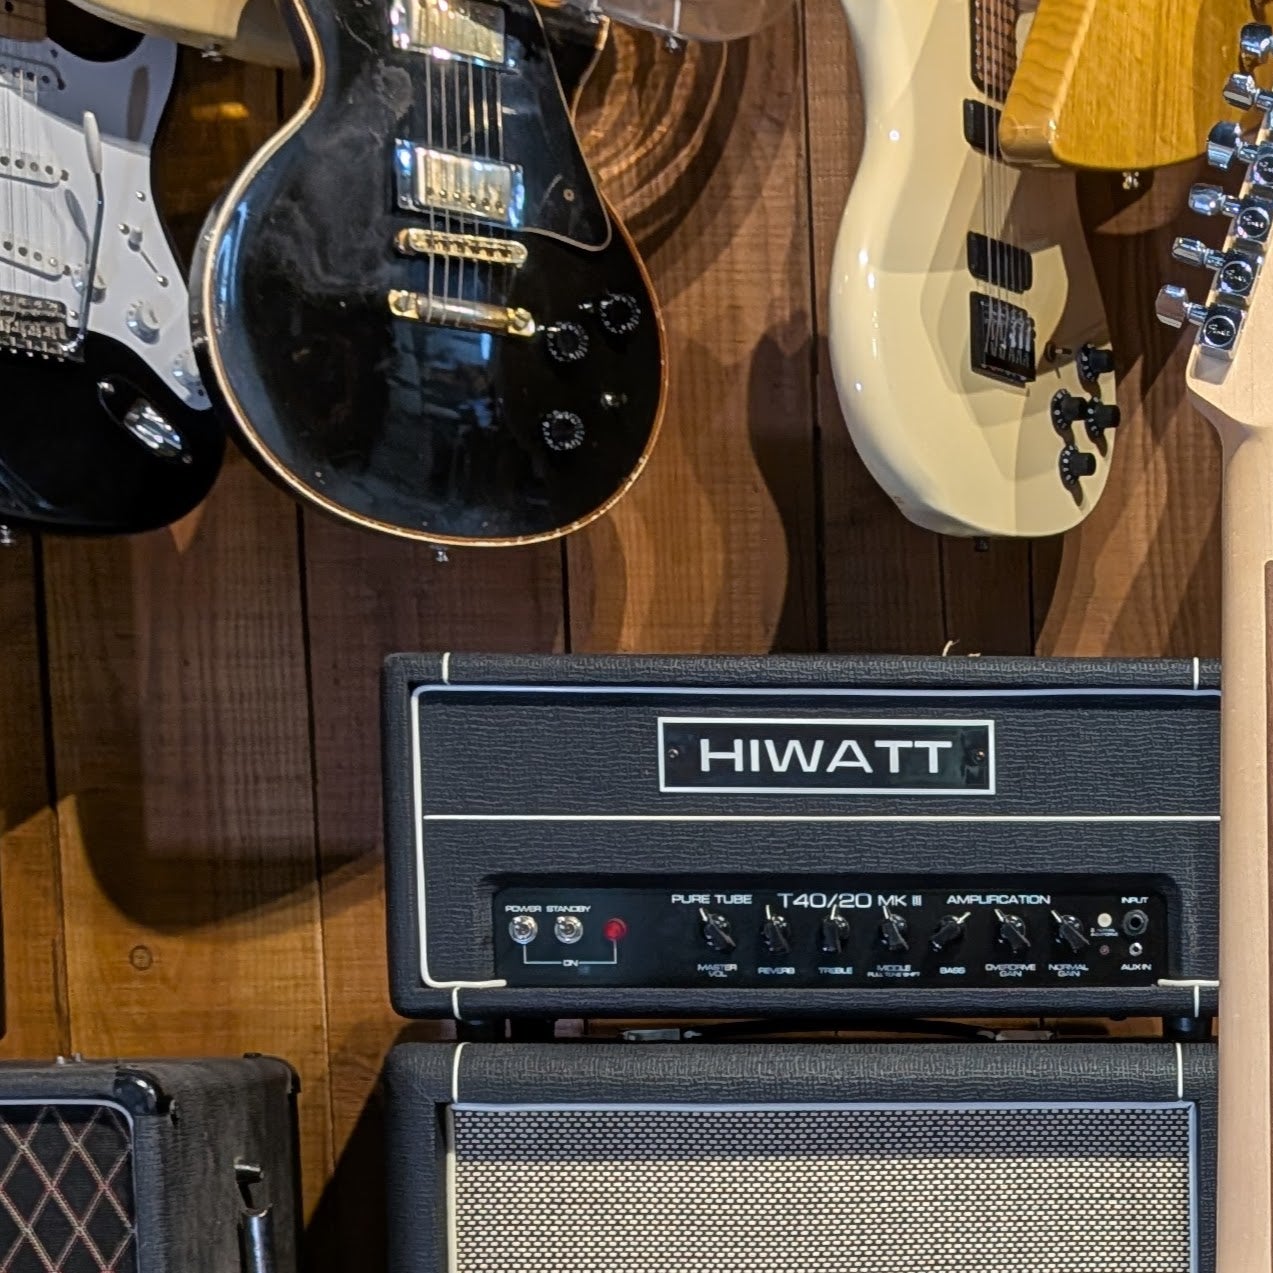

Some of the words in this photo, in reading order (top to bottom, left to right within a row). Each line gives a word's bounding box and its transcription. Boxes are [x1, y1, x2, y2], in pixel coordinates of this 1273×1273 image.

[700, 738, 952, 774] HIWATT
[671, 894, 711, 904] PURE
[714, 894, 752, 904] TUBE
[777, 893, 873, 909] T40/20
[878, 895, 907, 907] MK
[946, 895, 1051, 905] AMPLIFICATION
[505, 905, 542, 913] POWER
[546, 905, 591, 913] STANDBY
[562, 959, 579, 967] ON
[985, 963, 1036, 971] OVERDRIVE
[1048, 963, 1089, 971] NORMAL
[758, 967, 795, 975] REVERB
[818, 967, 853, 975] TREBLE
